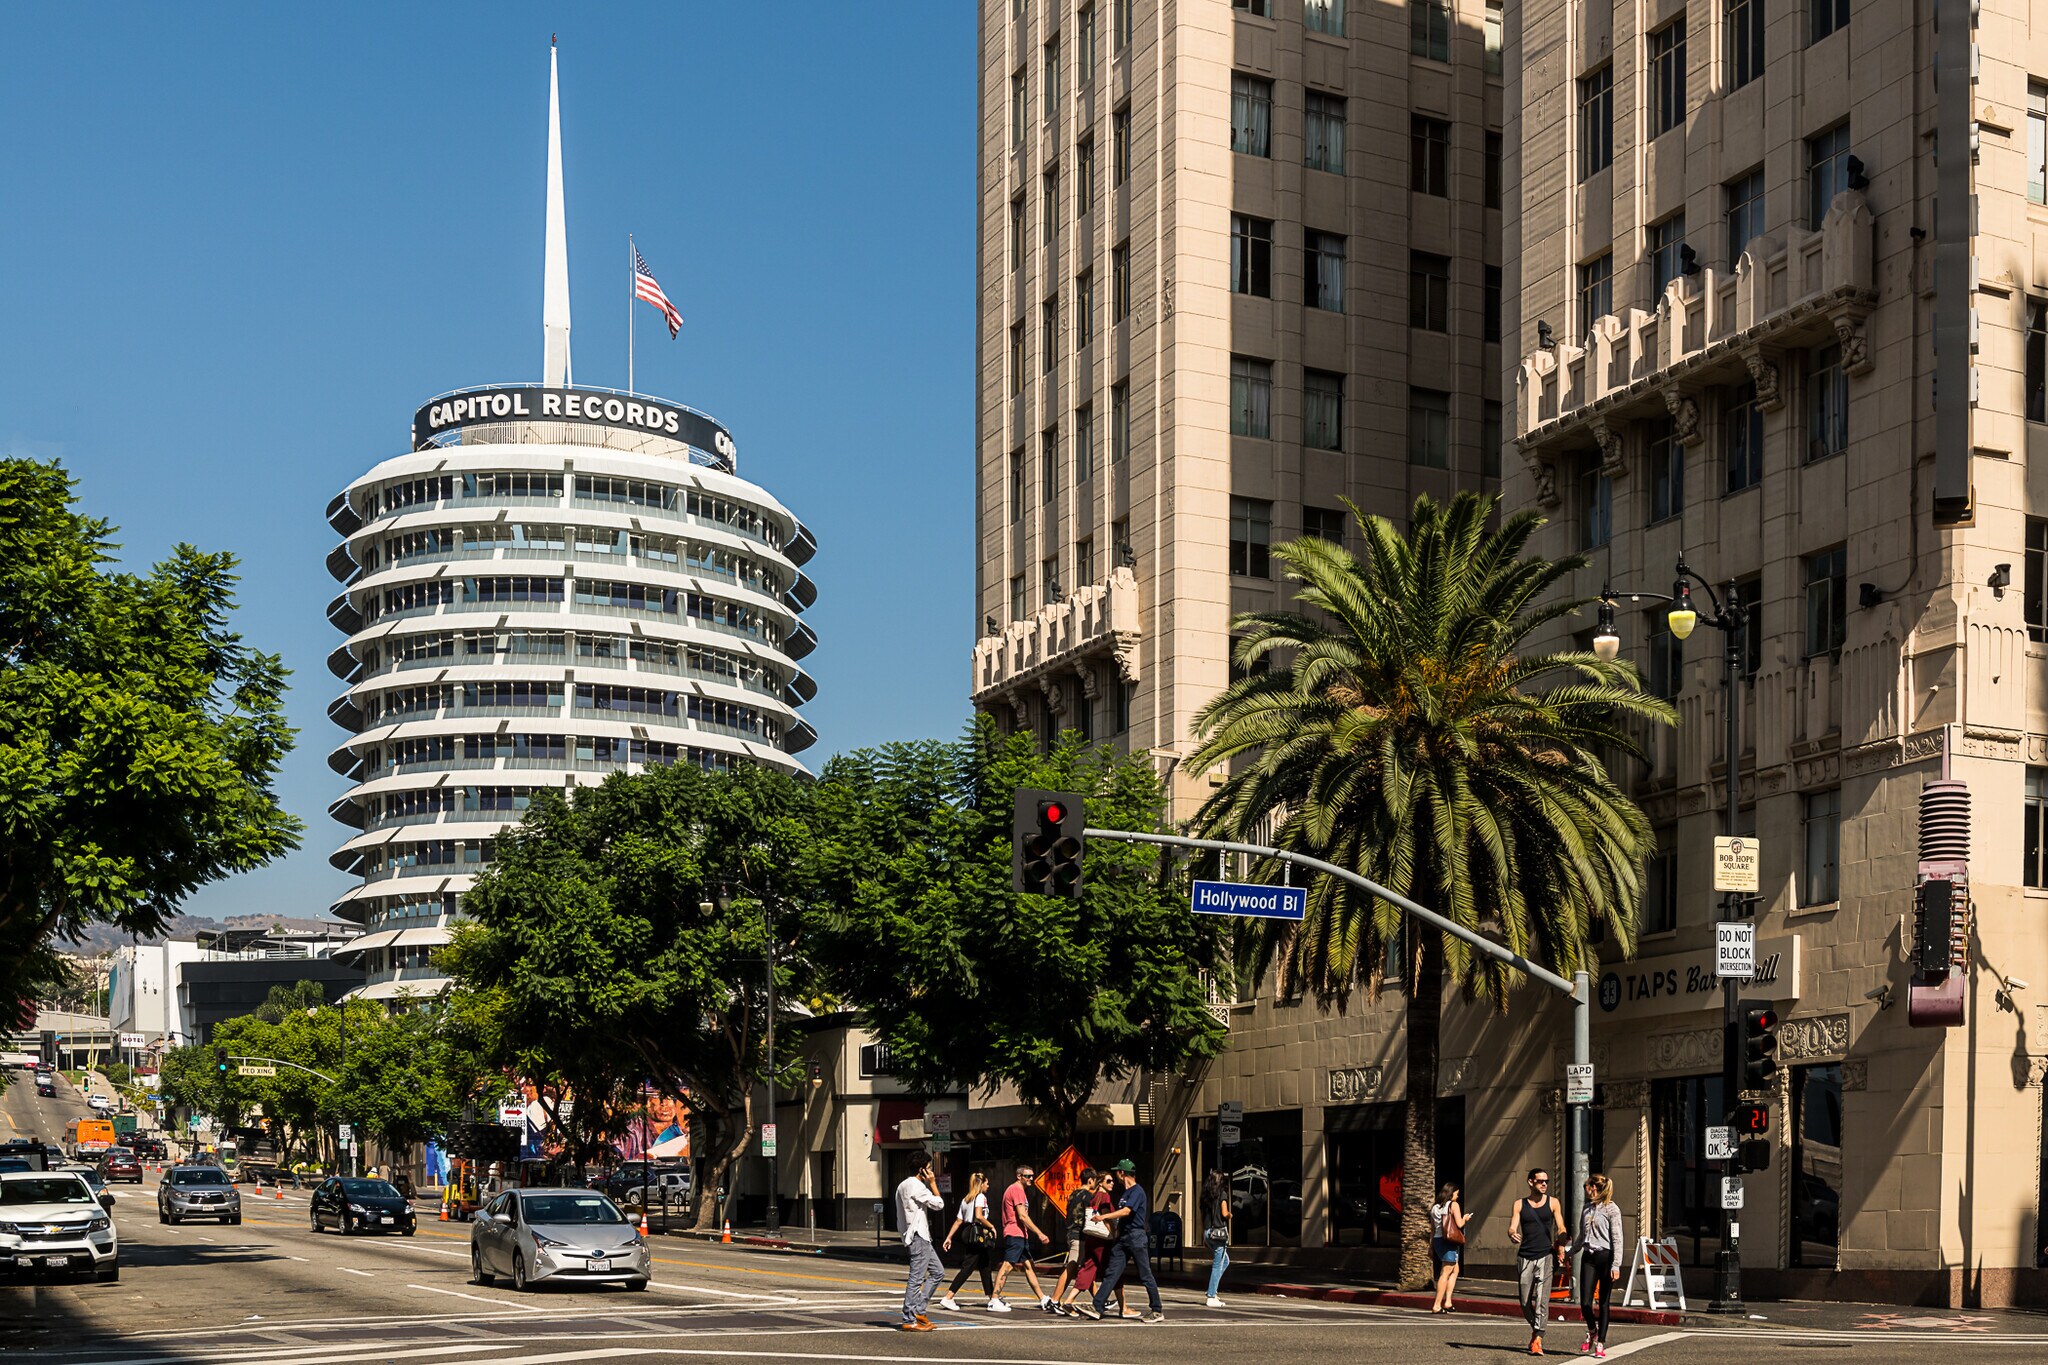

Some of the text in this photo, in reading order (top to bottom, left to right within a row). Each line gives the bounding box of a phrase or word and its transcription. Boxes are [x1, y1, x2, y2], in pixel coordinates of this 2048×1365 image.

[429, 393, 679, 434] CAPITOL RECORDS
[1719, 854, 1755, 864] BOB HOPE
[1723, 862, 1750, 870] SQUARE
[1200, 889, 1298, 911] Hollywood Bl
[1719, 930, 1752, 943] DO NOT
[1720, 947, 1751, 959] BLOCK
[1720, 962, 1752, 971] INTERSECTION
[1603, 980, 1617, 1004] 33
[1626, 969, 1678, 1001] TAPS
[1686, 965, 1719, 993] Bar
[1569, 1066, 1592, 1075] LAPD
[1751, 1110, 1766, 1128] 21
[1708, 1143, 1720, 1156] OK
[1056, 1183, 1080, 1191] CLOSE
